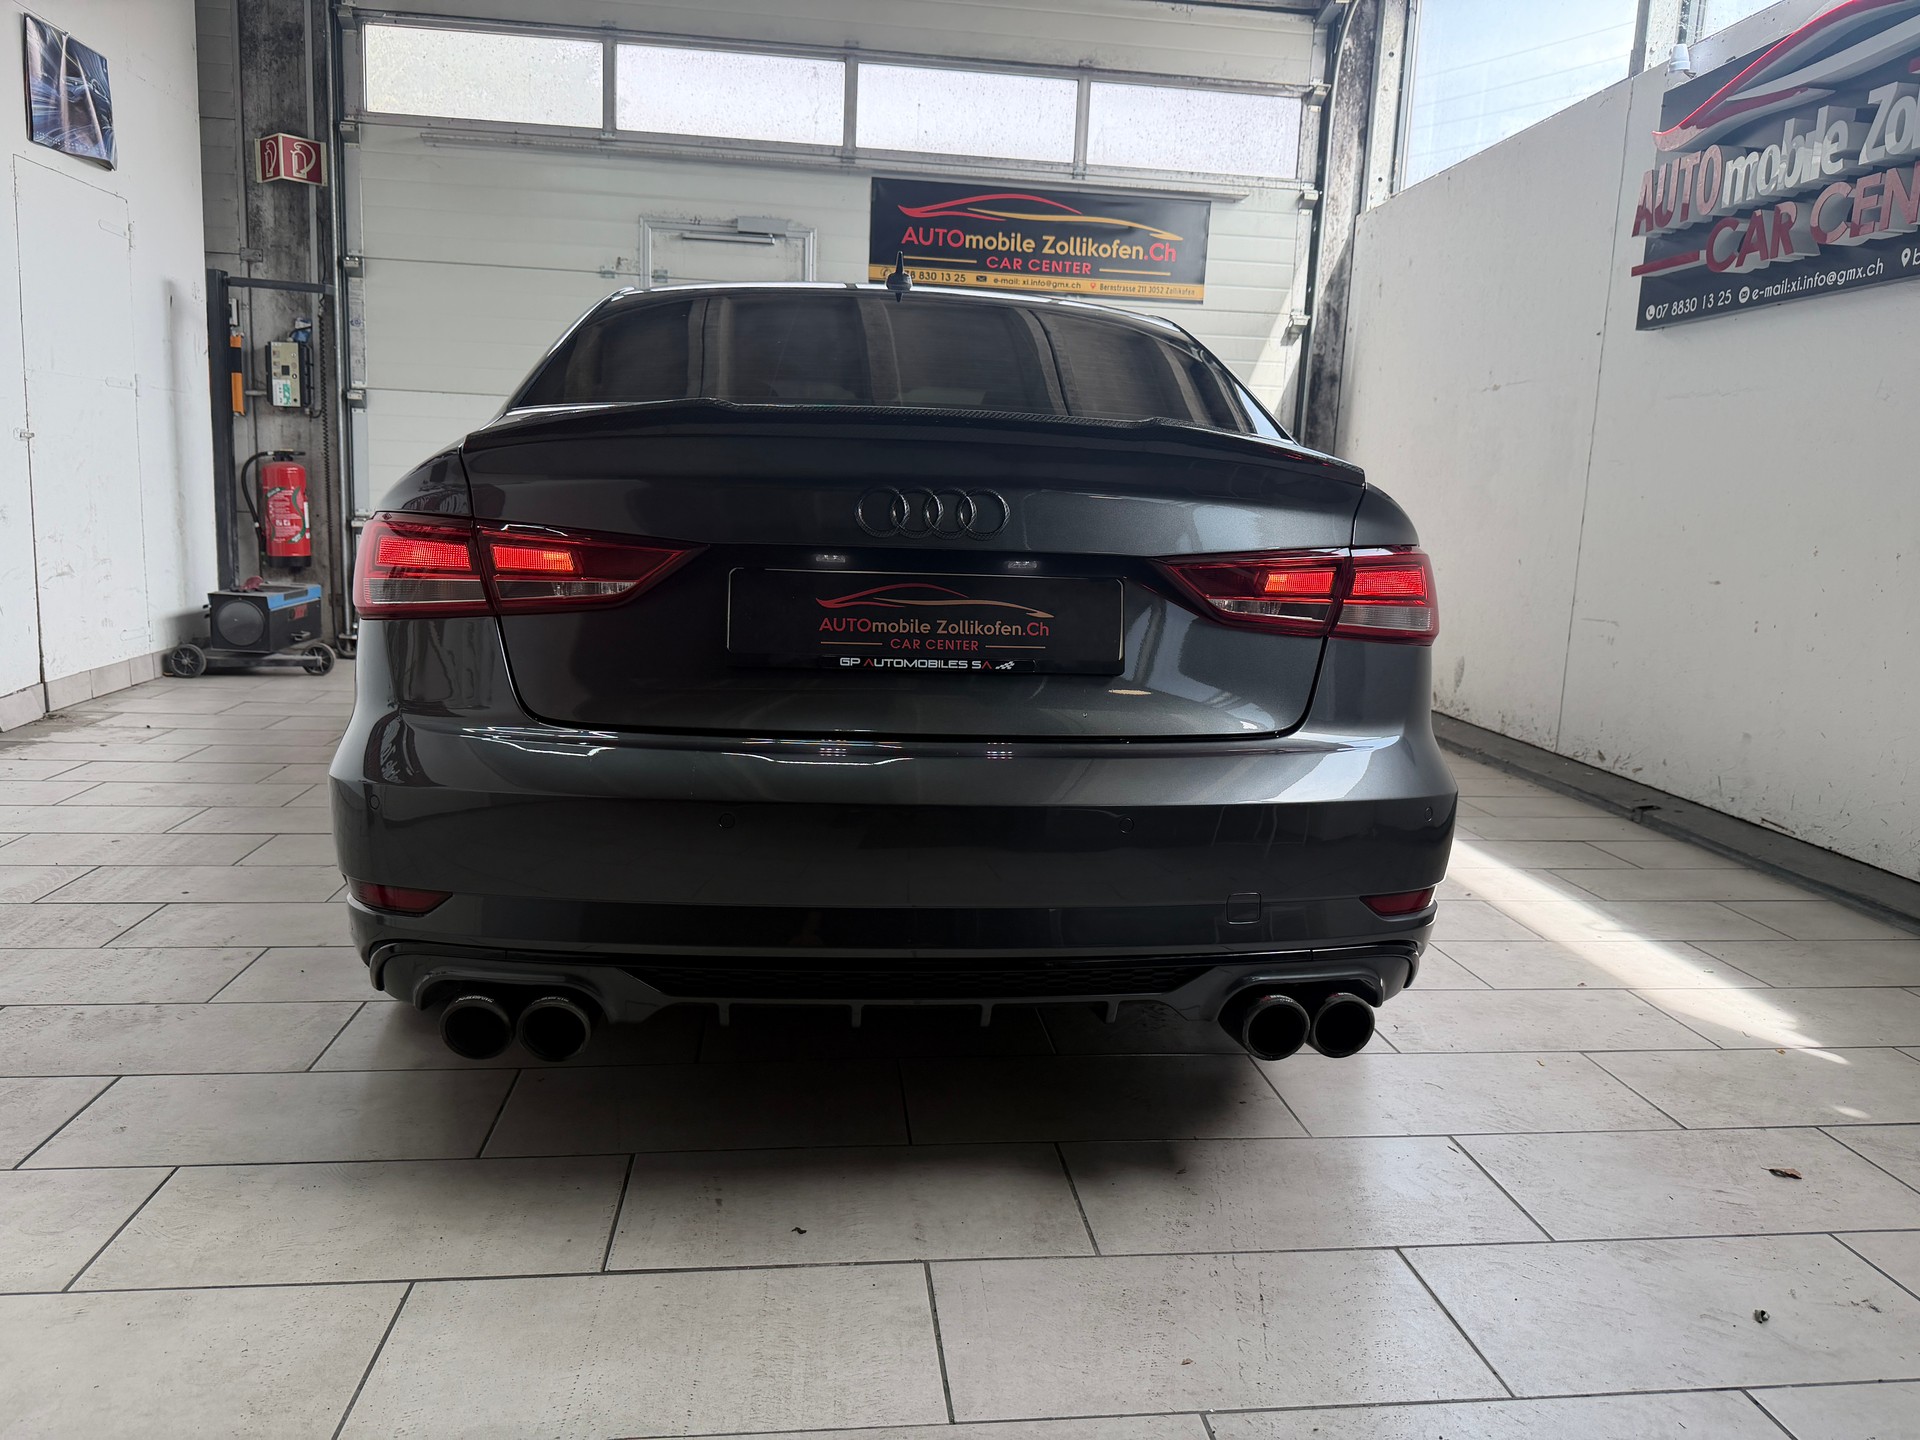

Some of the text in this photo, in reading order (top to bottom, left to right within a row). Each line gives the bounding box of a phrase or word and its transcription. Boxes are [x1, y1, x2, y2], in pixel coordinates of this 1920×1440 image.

[901, 226, 1177, 262] AUTOmobile Zollikofen.Ch
[1706, 202, 1798, 273] CAR
[986, 256, 1091, 275] CAR CENTER
[918, 271, 937, 281] 830
[941, 272, 951, 282] 13
[954, 273, 966, 283] 25
[1099, 283, 1136, 293] Bernstrasse
[1655, 303, 1669, 319] 07
[1671, 297, 1698, 316] 8830
[1702, 293, 1715, 309] 13
[1717, 289, 1732, 305] 25
[819, 617, 1050, 636] AUTOmobile Zollikofen.Ch
[890, 638, 979, 651] CAR CENTER
[839, 657, 992, 670] GP AUTOMOBILES SA
